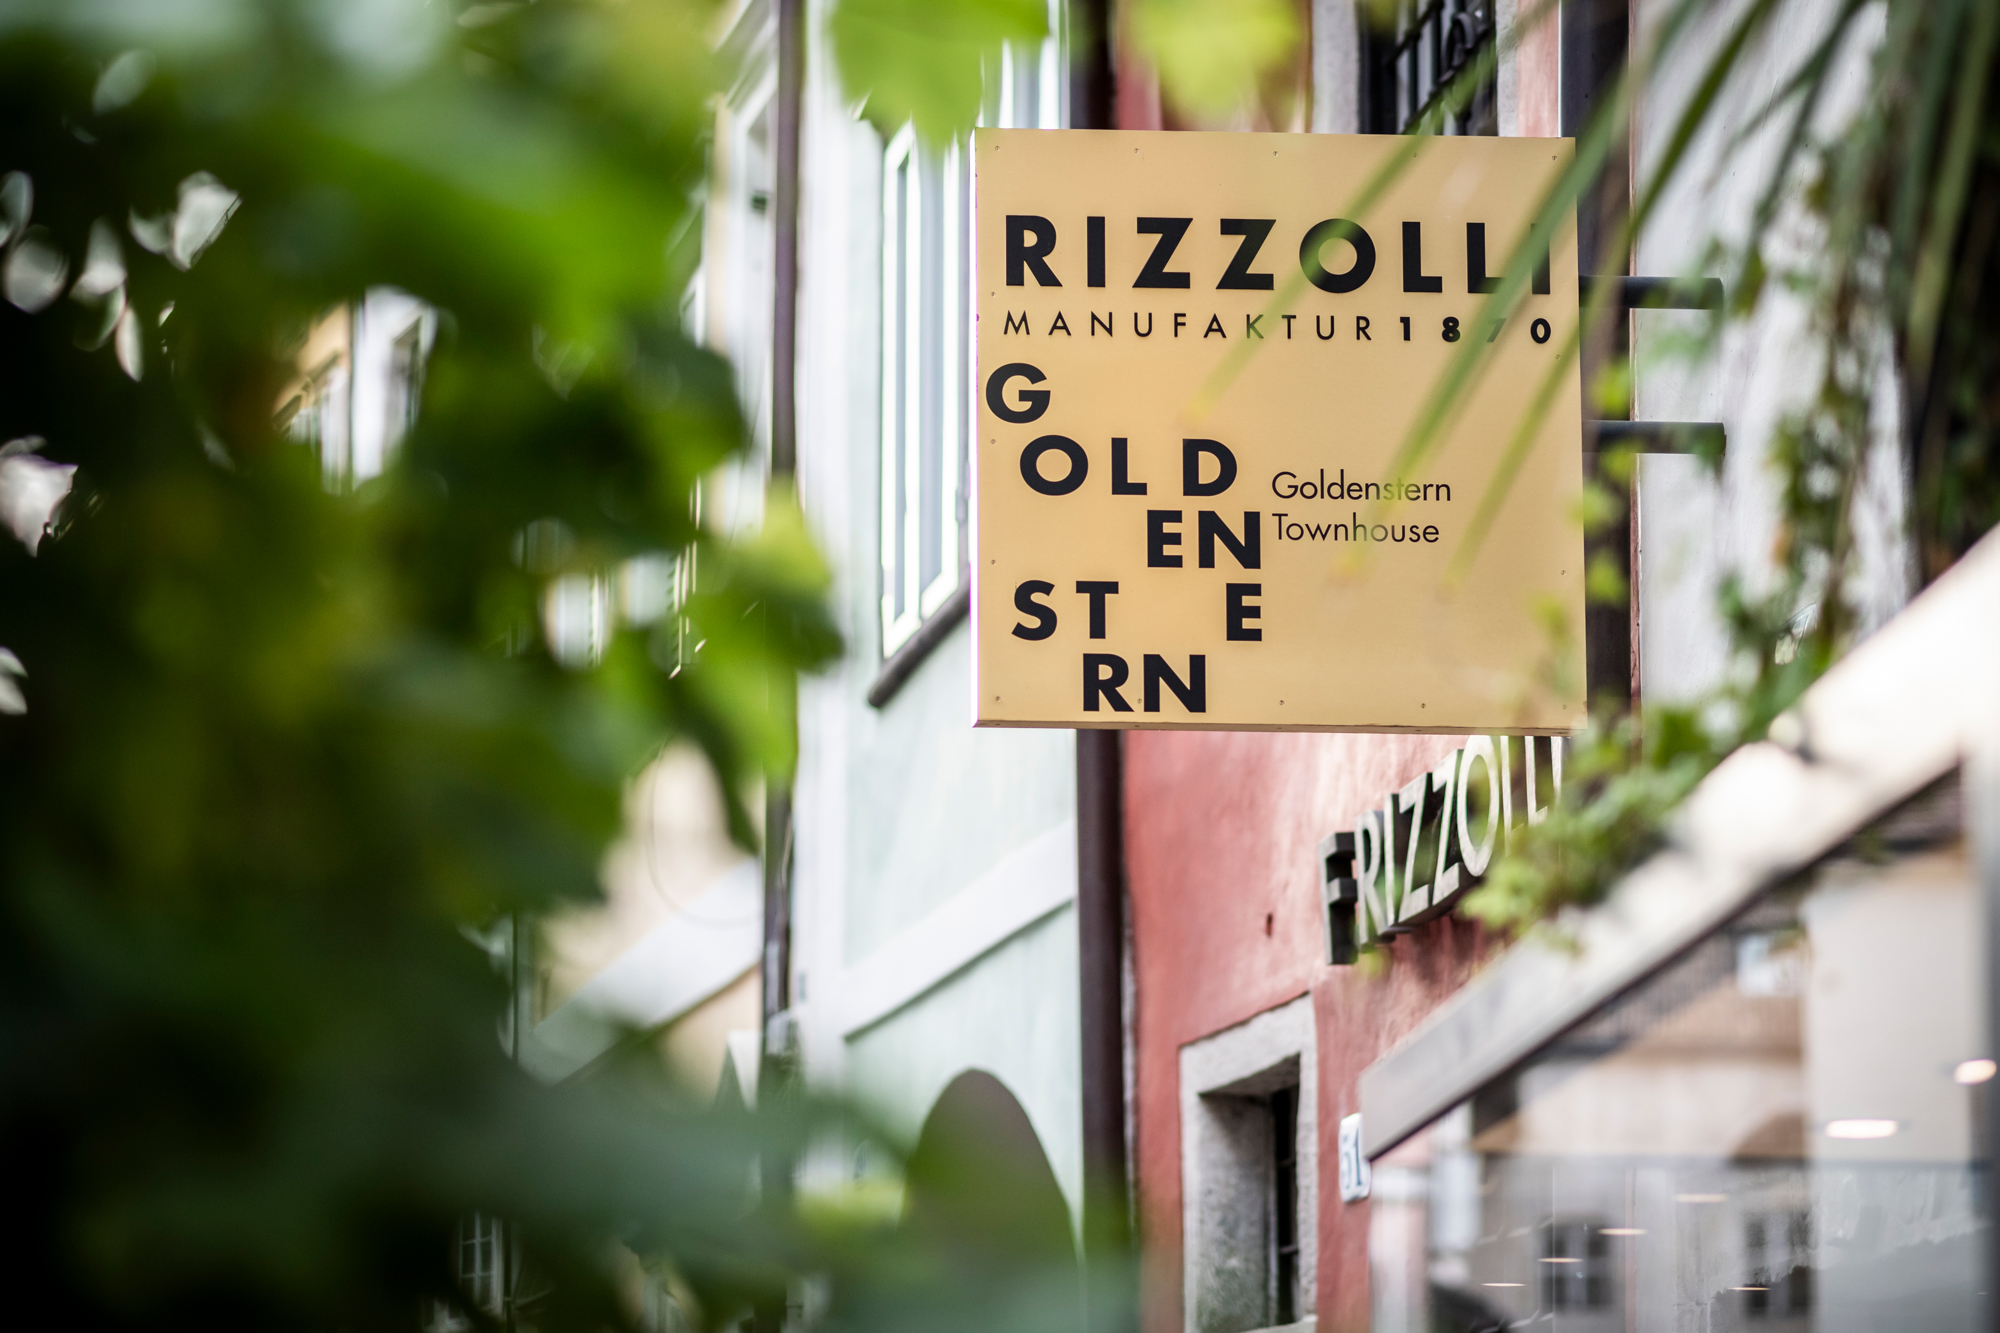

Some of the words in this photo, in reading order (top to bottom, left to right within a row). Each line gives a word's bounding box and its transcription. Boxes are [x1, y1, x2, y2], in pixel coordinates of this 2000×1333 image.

[1006, 215, 1550, 294] RIZZOLLI
[986, 363, 1051, 423] G
[1020, 435, 1238, 497] OLD
[1271, 469, 1451, 502] Goldenstern
[1147, 510, 1262, 570] EN
[1271, 514, 1440, 544] Townhouse
[1083, 653, 1207, 714] RN
